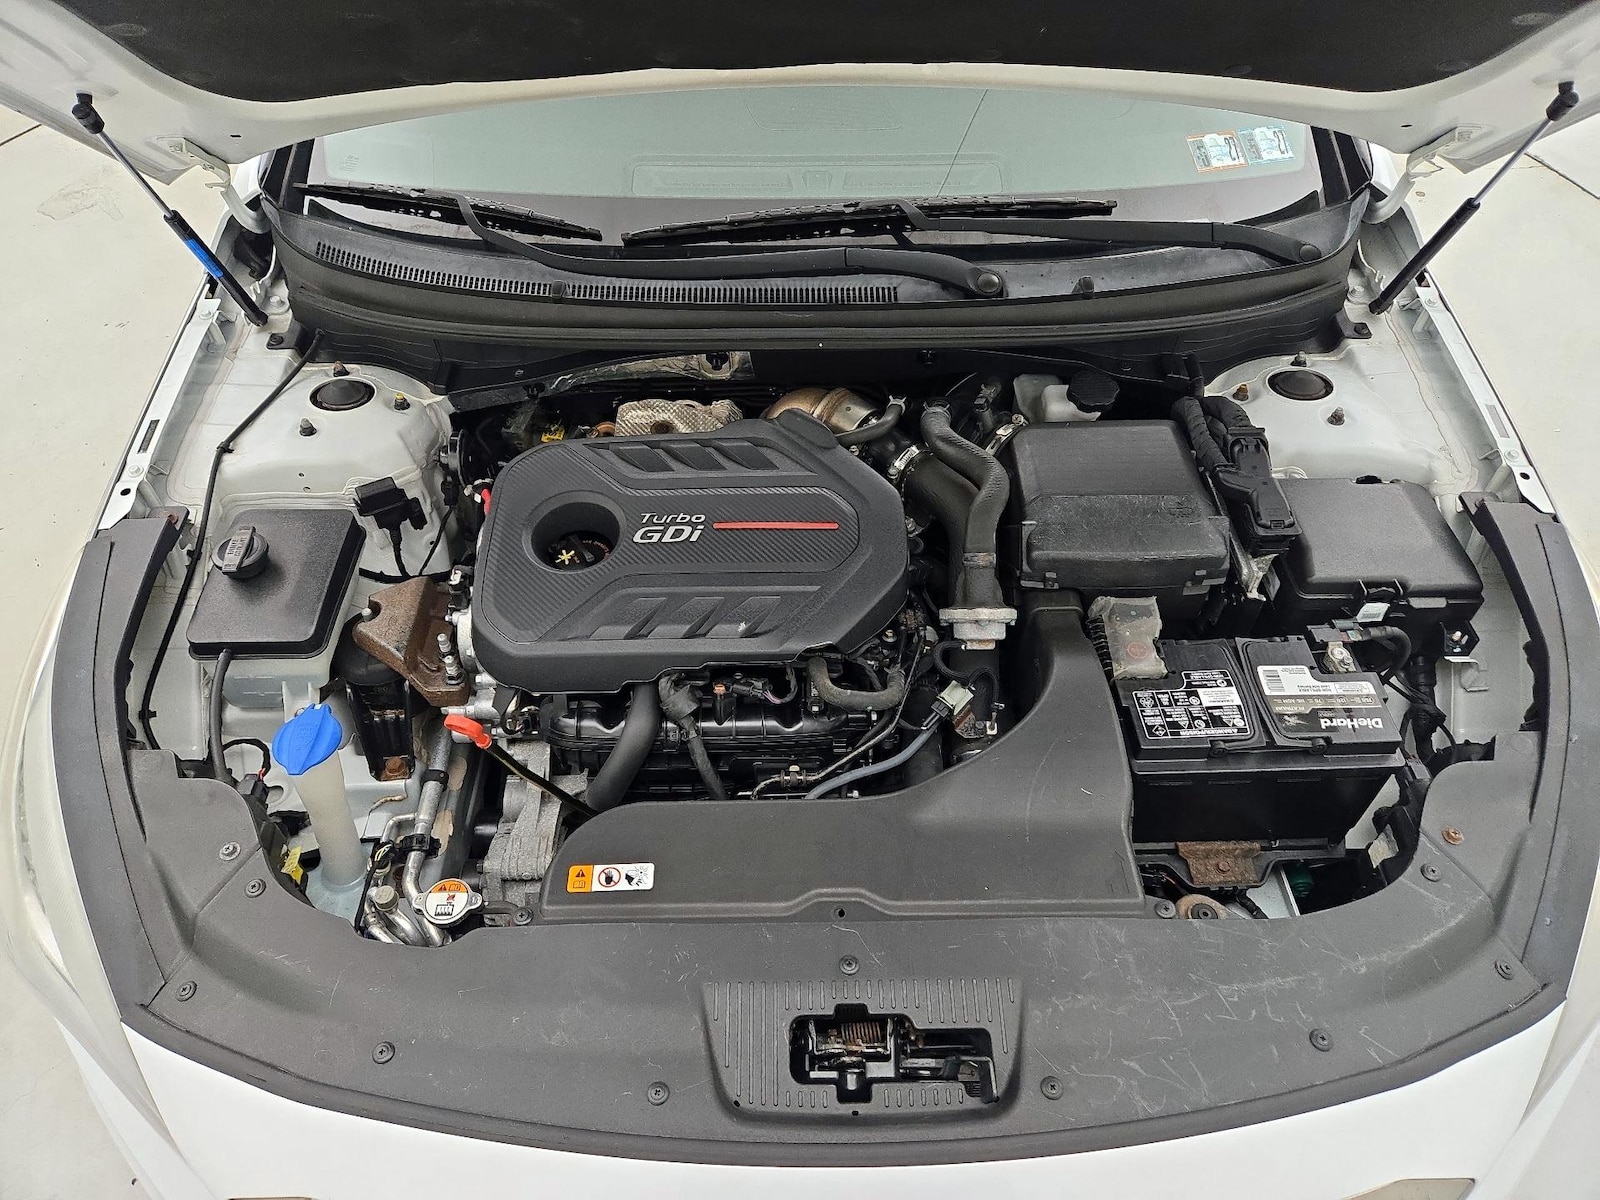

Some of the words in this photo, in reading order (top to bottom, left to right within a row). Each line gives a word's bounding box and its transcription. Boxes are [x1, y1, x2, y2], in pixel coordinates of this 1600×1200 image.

[640, 512, 706, 524] Turbo
[632, 525, 704, 543] GDi
[1320, 717, 1383, 730] DieHard
